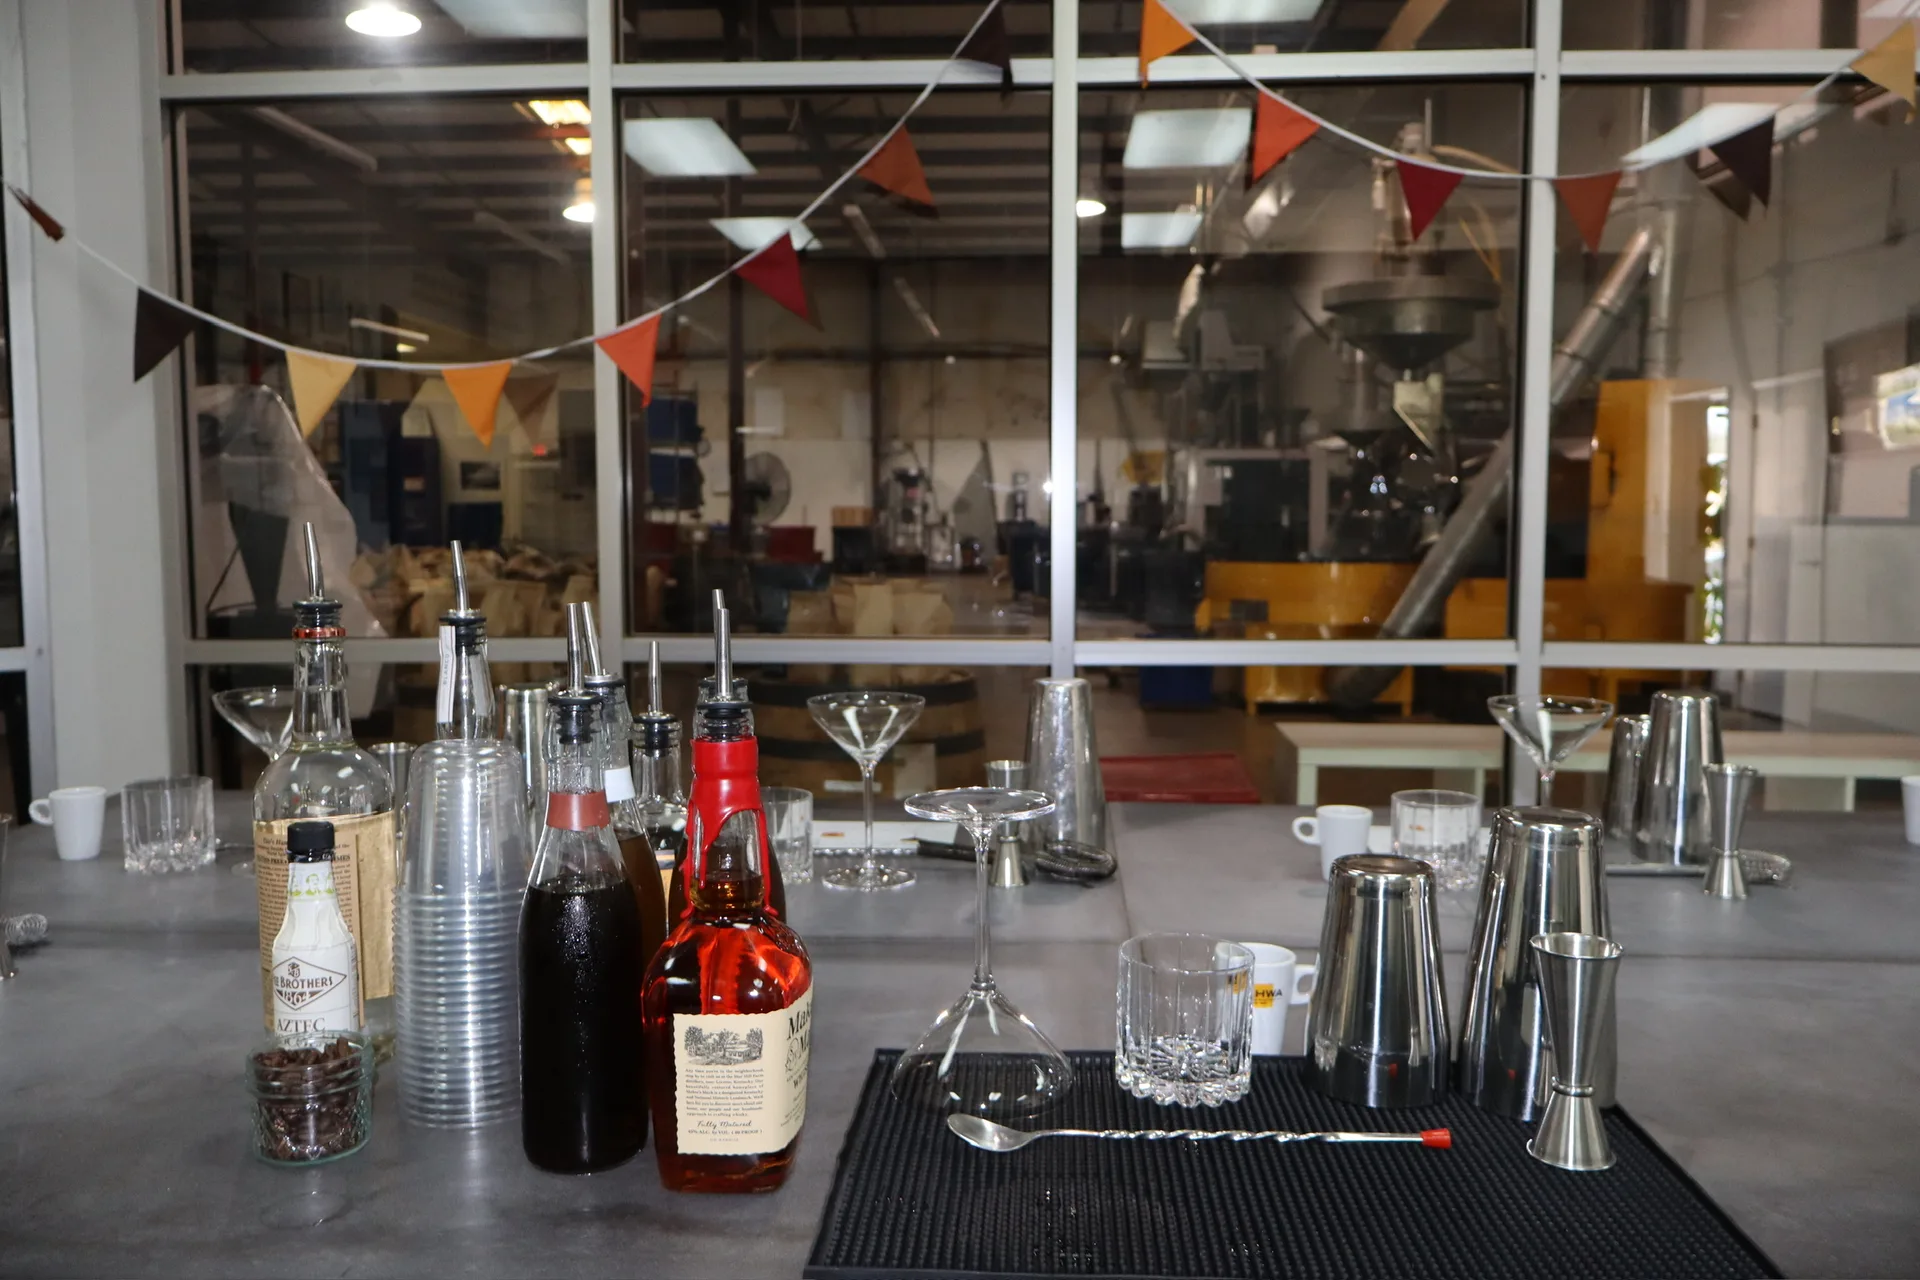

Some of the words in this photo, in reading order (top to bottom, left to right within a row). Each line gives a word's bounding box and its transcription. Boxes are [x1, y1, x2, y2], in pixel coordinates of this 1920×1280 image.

[280, 976, 333, 989] BROTHERS
[283, 990, 309, 1006] 1864
[1255, 988, 1283, 998] HWA
[277, 1017, 326, 1033] AZTEC
[697, 1120, 717, 1130] Fully
